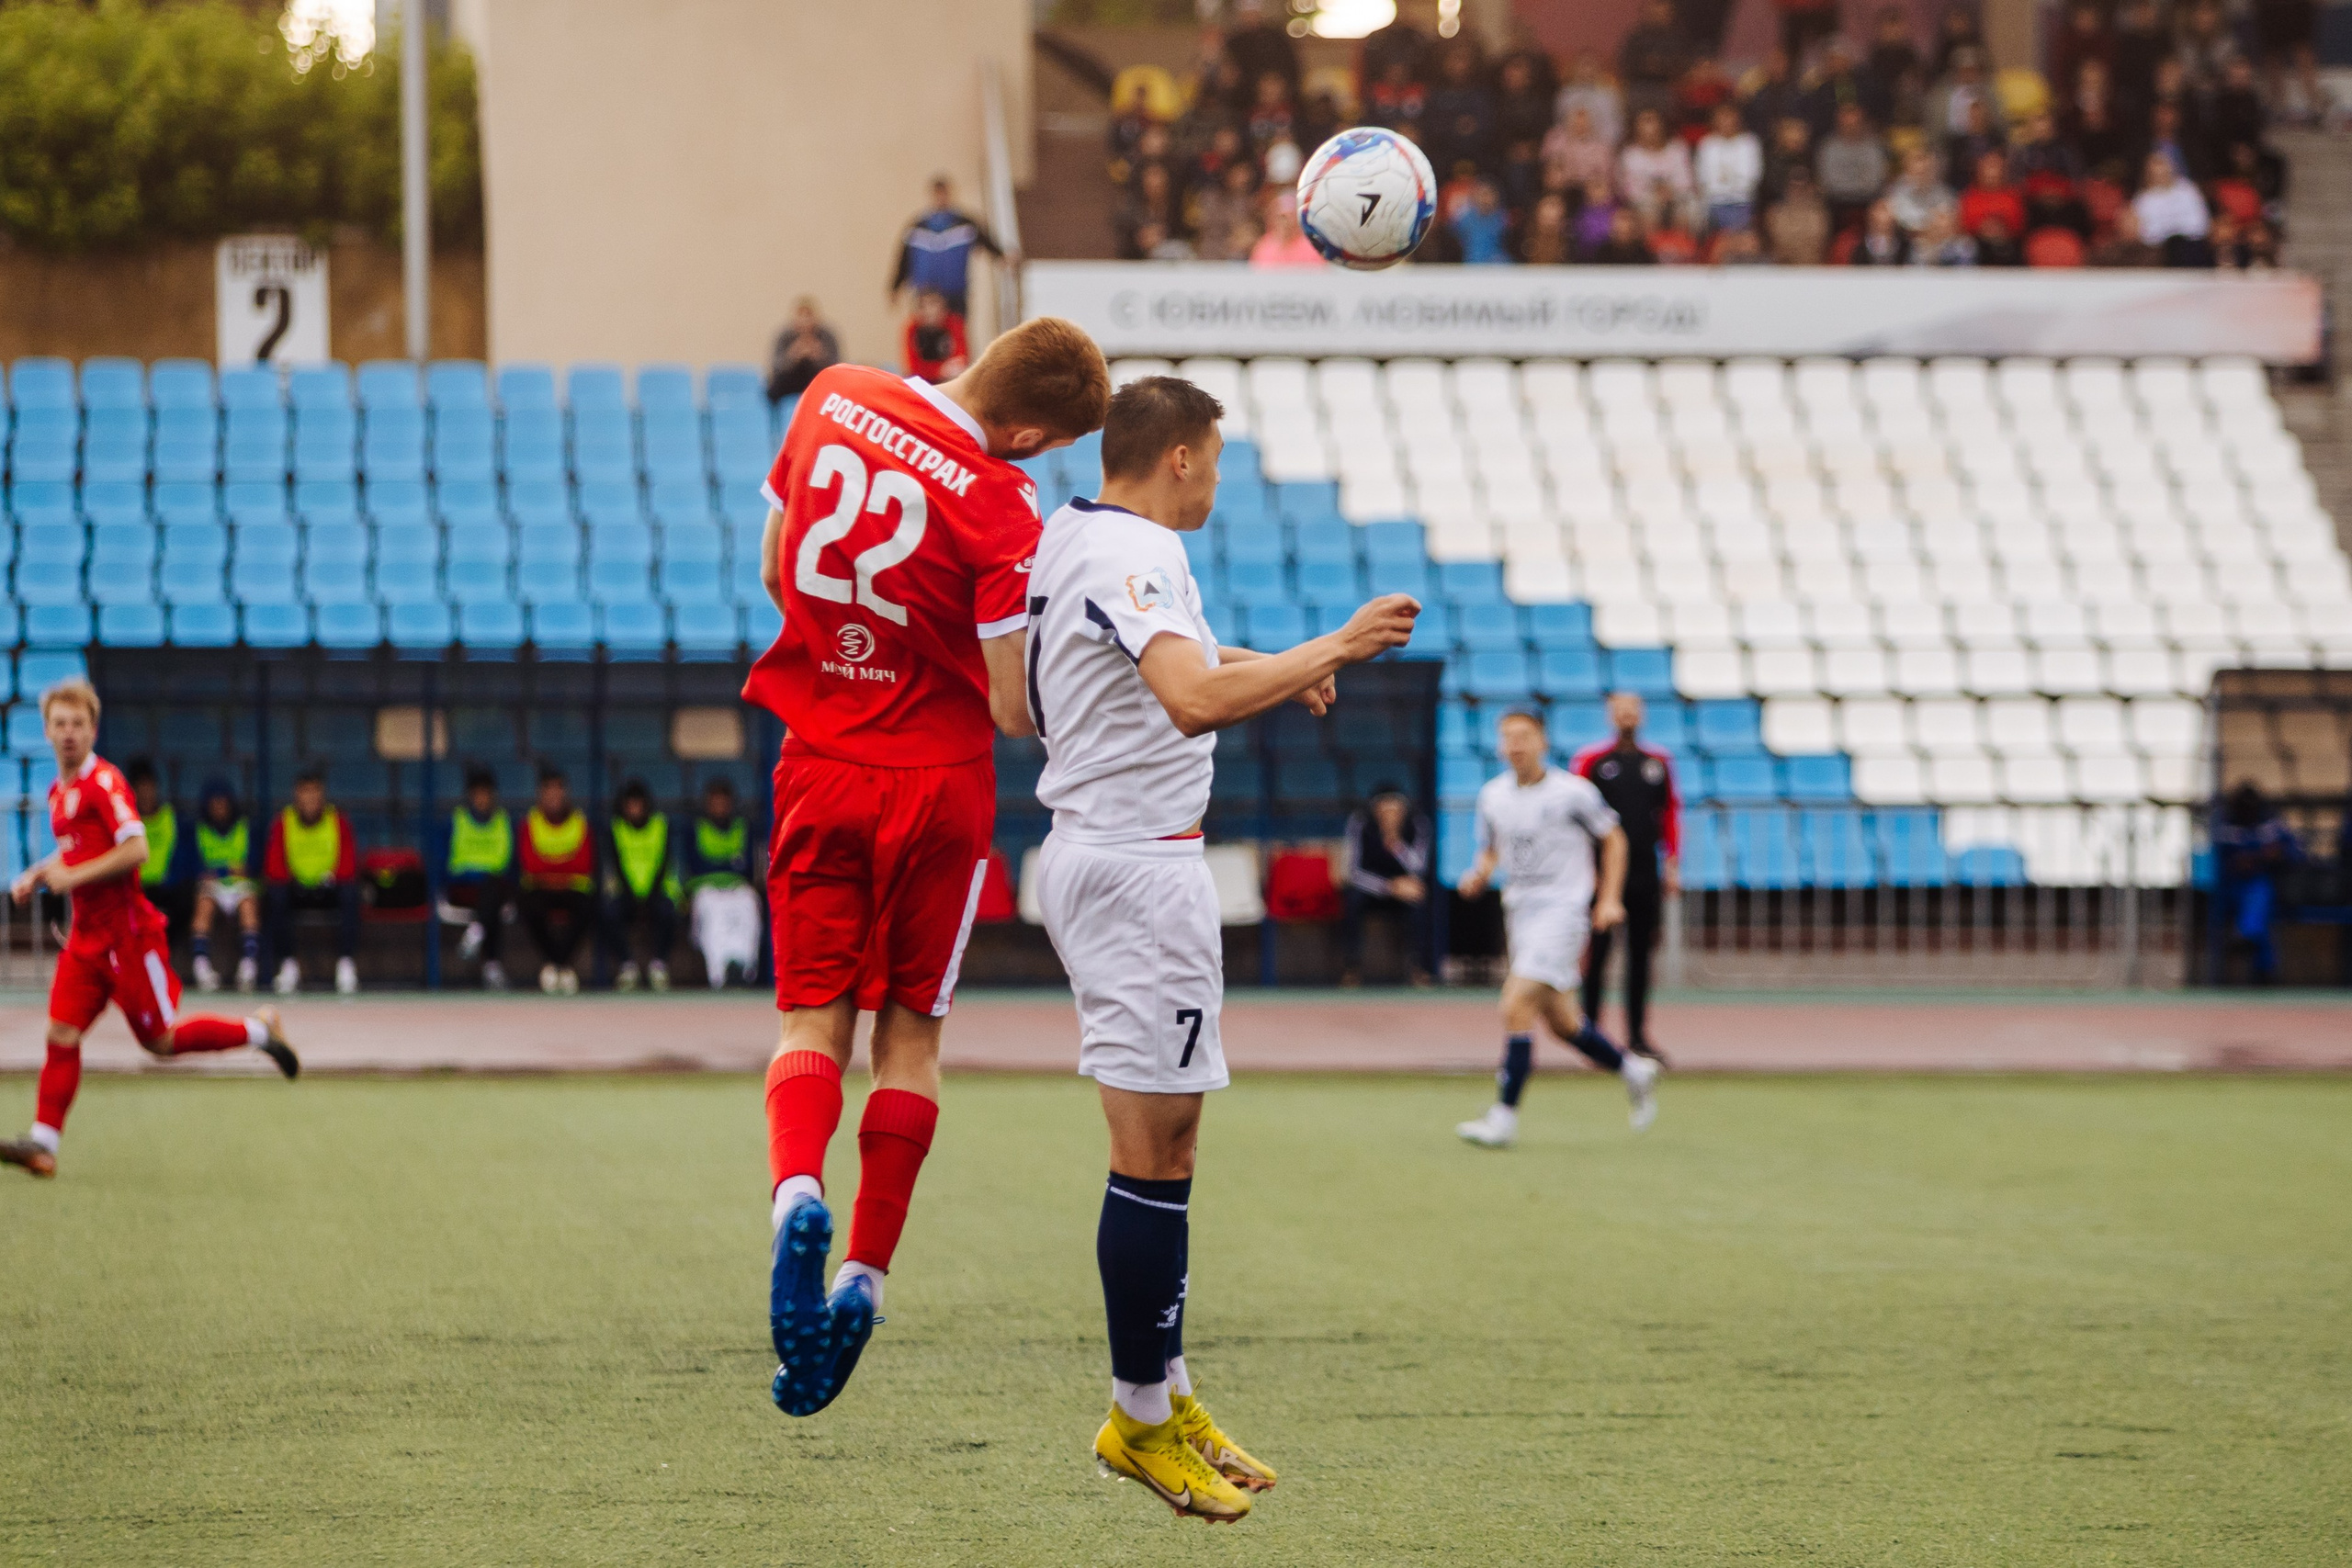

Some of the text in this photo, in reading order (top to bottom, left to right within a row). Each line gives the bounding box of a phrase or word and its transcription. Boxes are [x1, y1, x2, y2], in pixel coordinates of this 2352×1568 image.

[254, 283, 291, 362] 2
[820, 393, 978, 497] РОСГОССТРАХ
[796, 445, 927, 626] 22
[1176, 1008, 1203, 1068] 7
